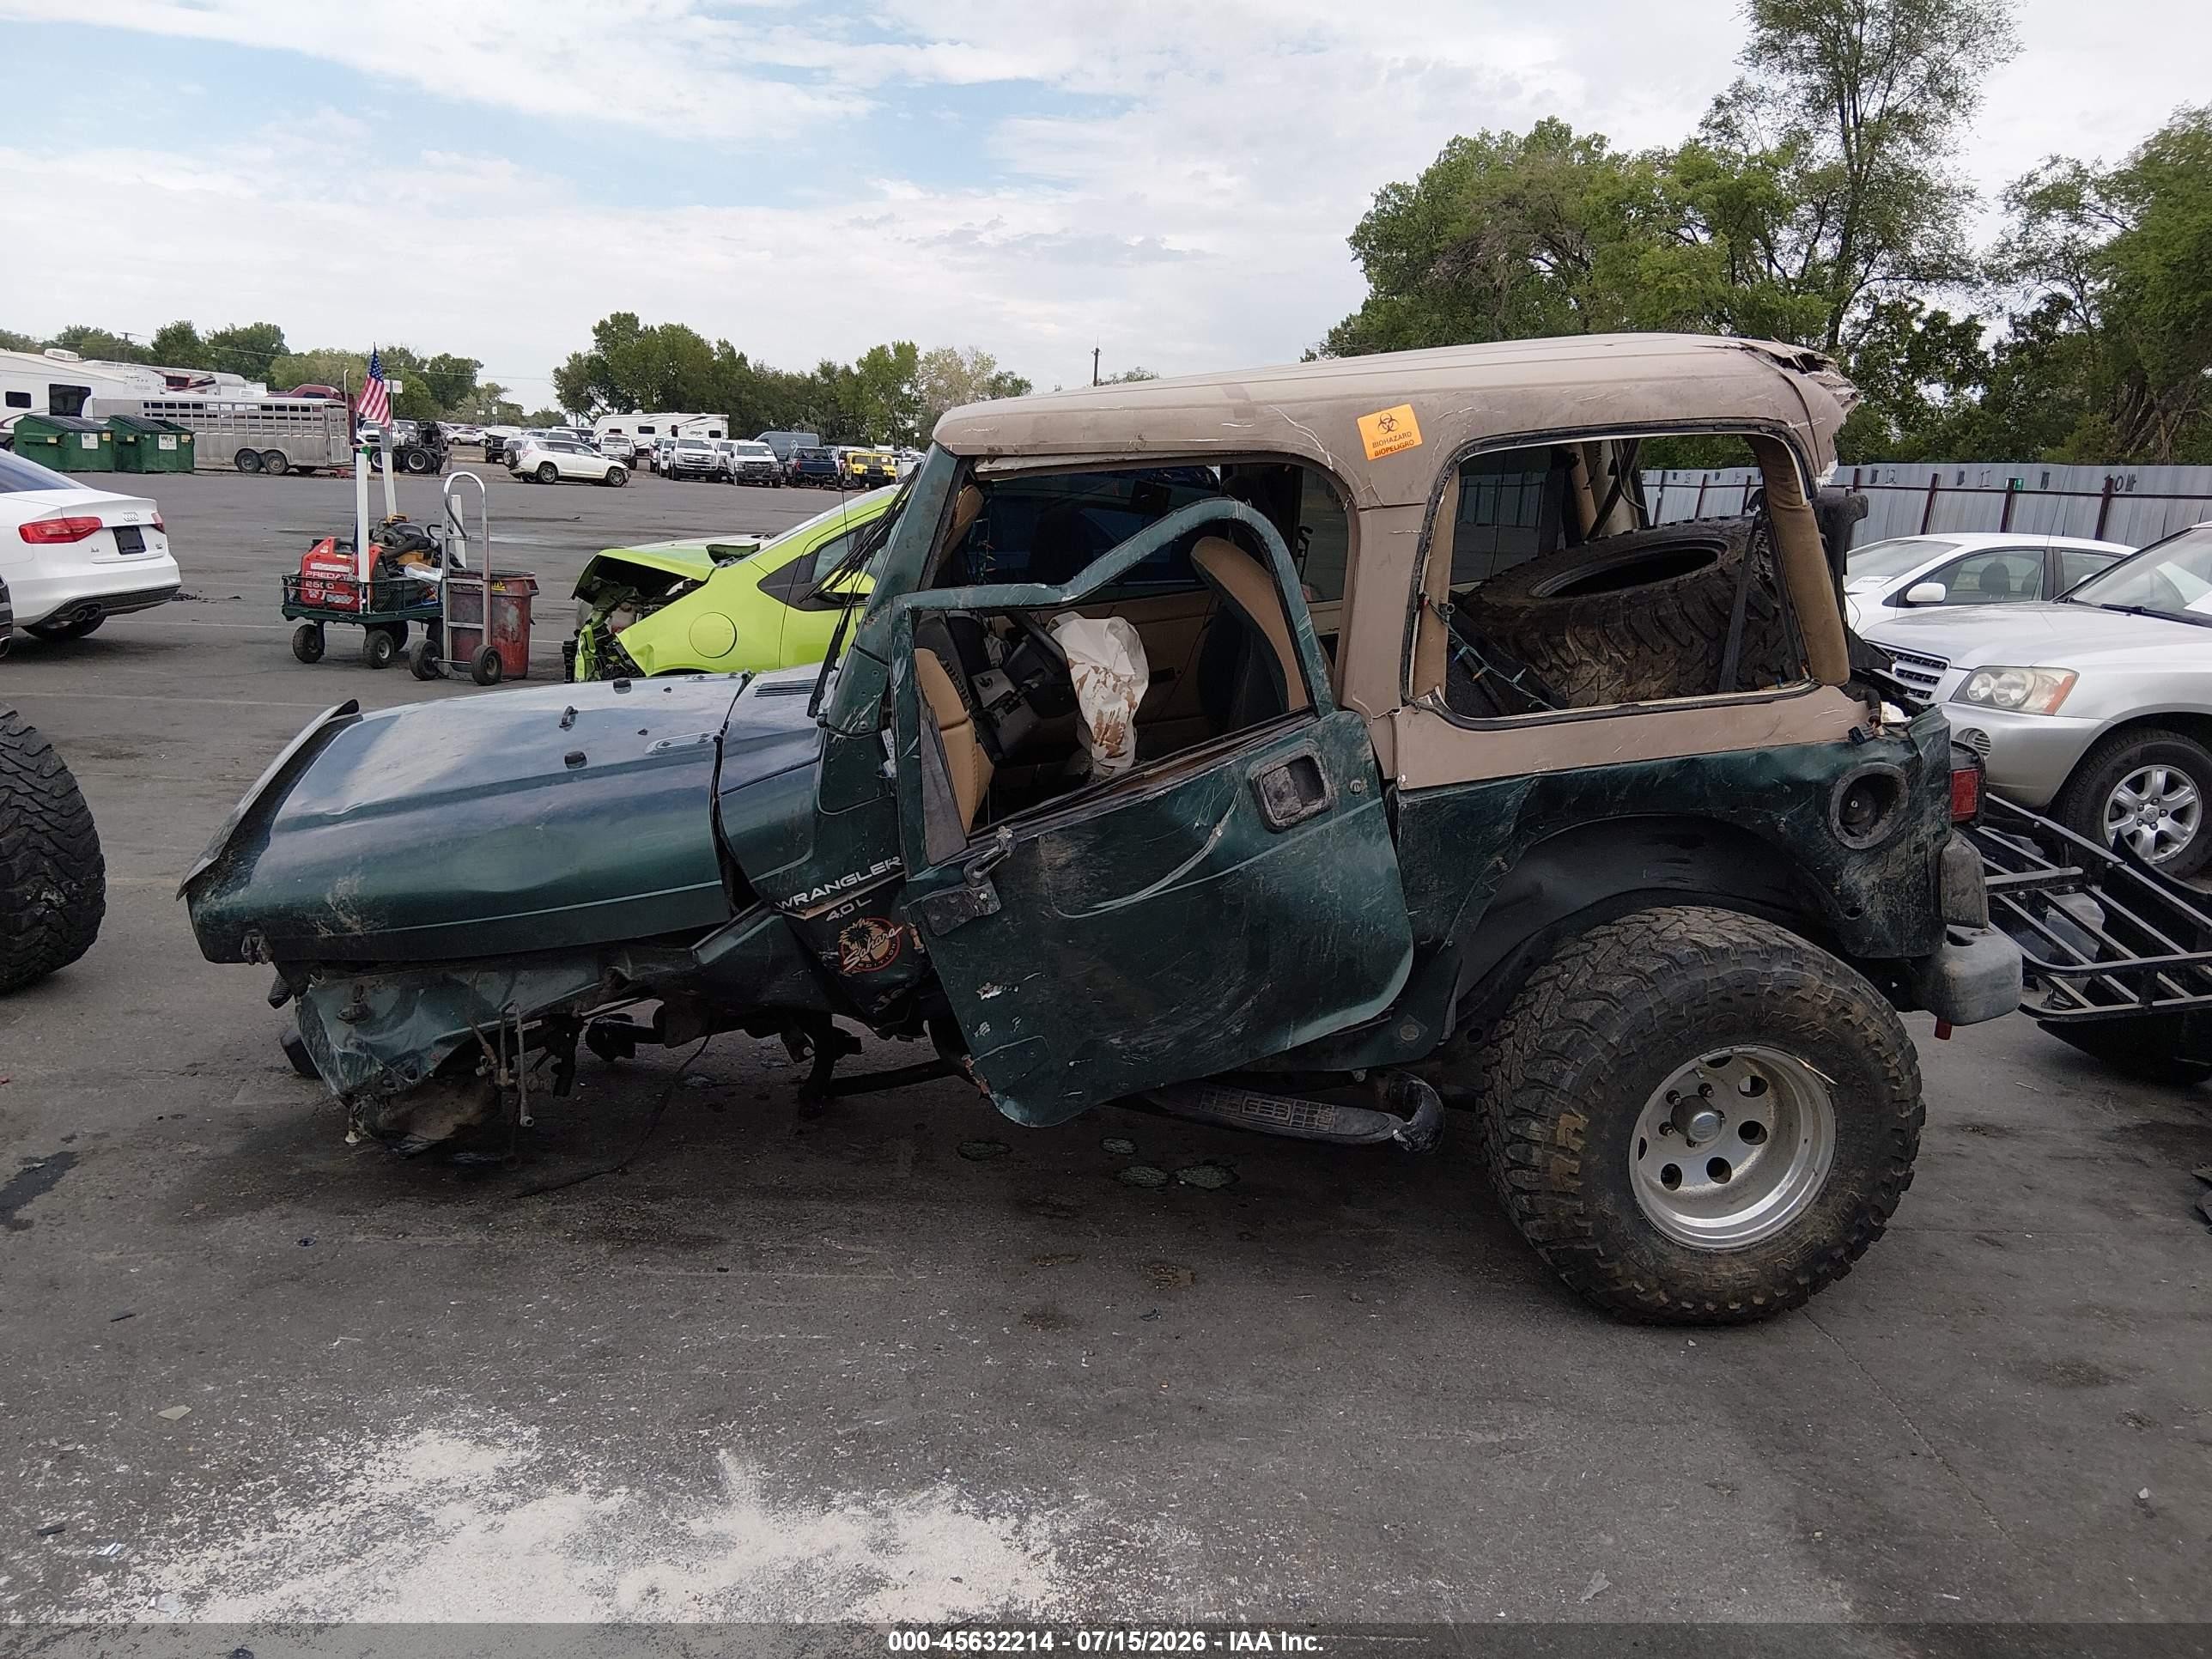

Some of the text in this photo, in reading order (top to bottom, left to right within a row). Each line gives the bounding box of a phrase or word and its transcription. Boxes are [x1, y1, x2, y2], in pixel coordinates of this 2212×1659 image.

[1372, 431, 1413, 448] BIOHAZARD
[1374, 439, 1414, 457] BIOPELIGRO
[305, 570, 357, 581] PREDAT
[776, 856, 902, 910] WRANGLER
[843, 927, 902, 973] Sahara
